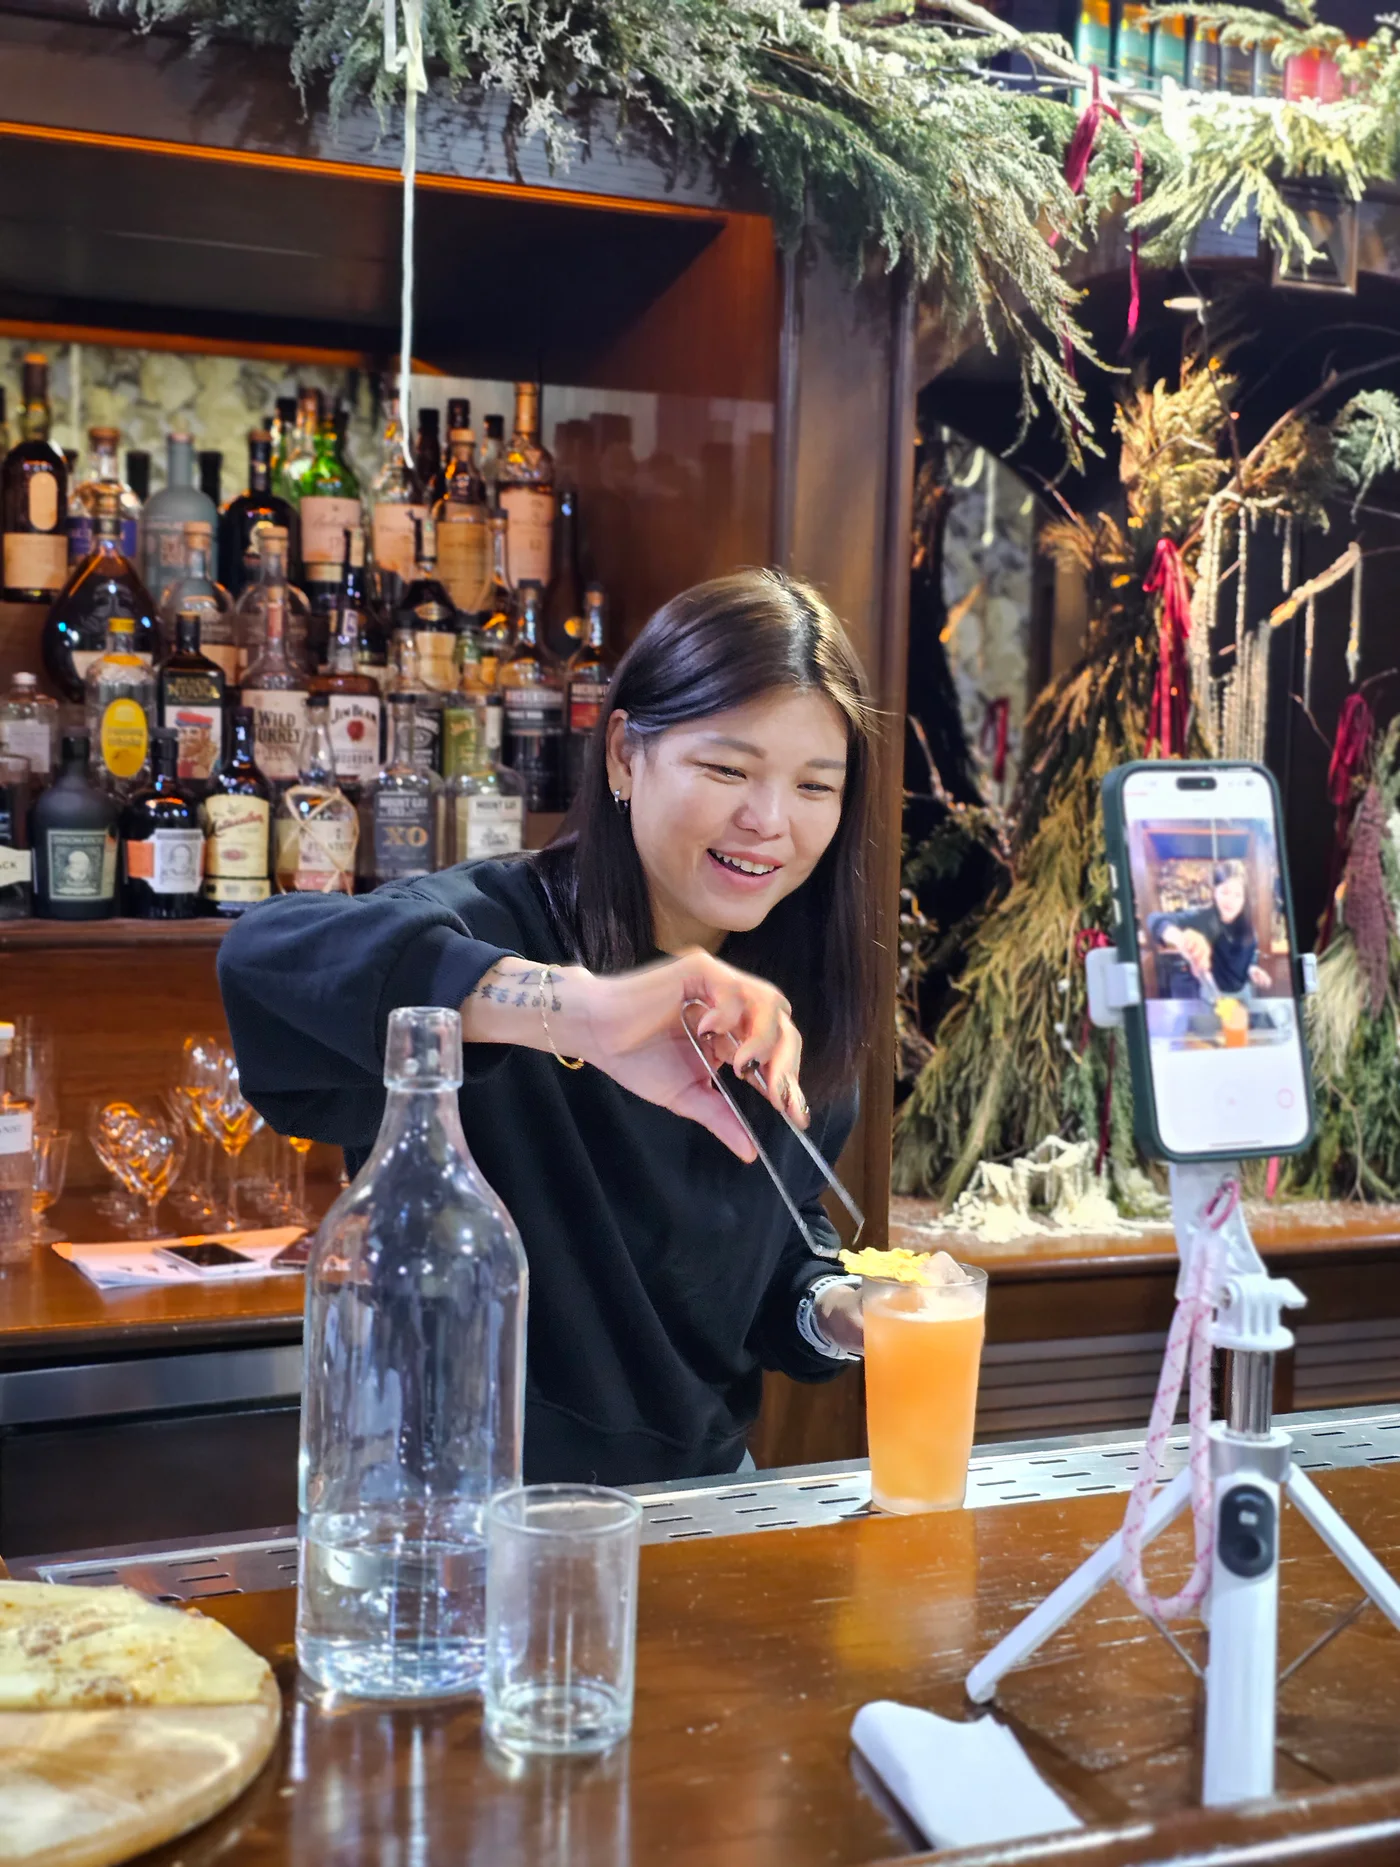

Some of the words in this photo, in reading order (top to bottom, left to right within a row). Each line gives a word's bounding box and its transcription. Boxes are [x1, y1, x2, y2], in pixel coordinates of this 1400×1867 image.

[258, 709, 297, 728] WILD
[255, 727, 301, 744] URKEY
[382, 825, 429, 848] XO
